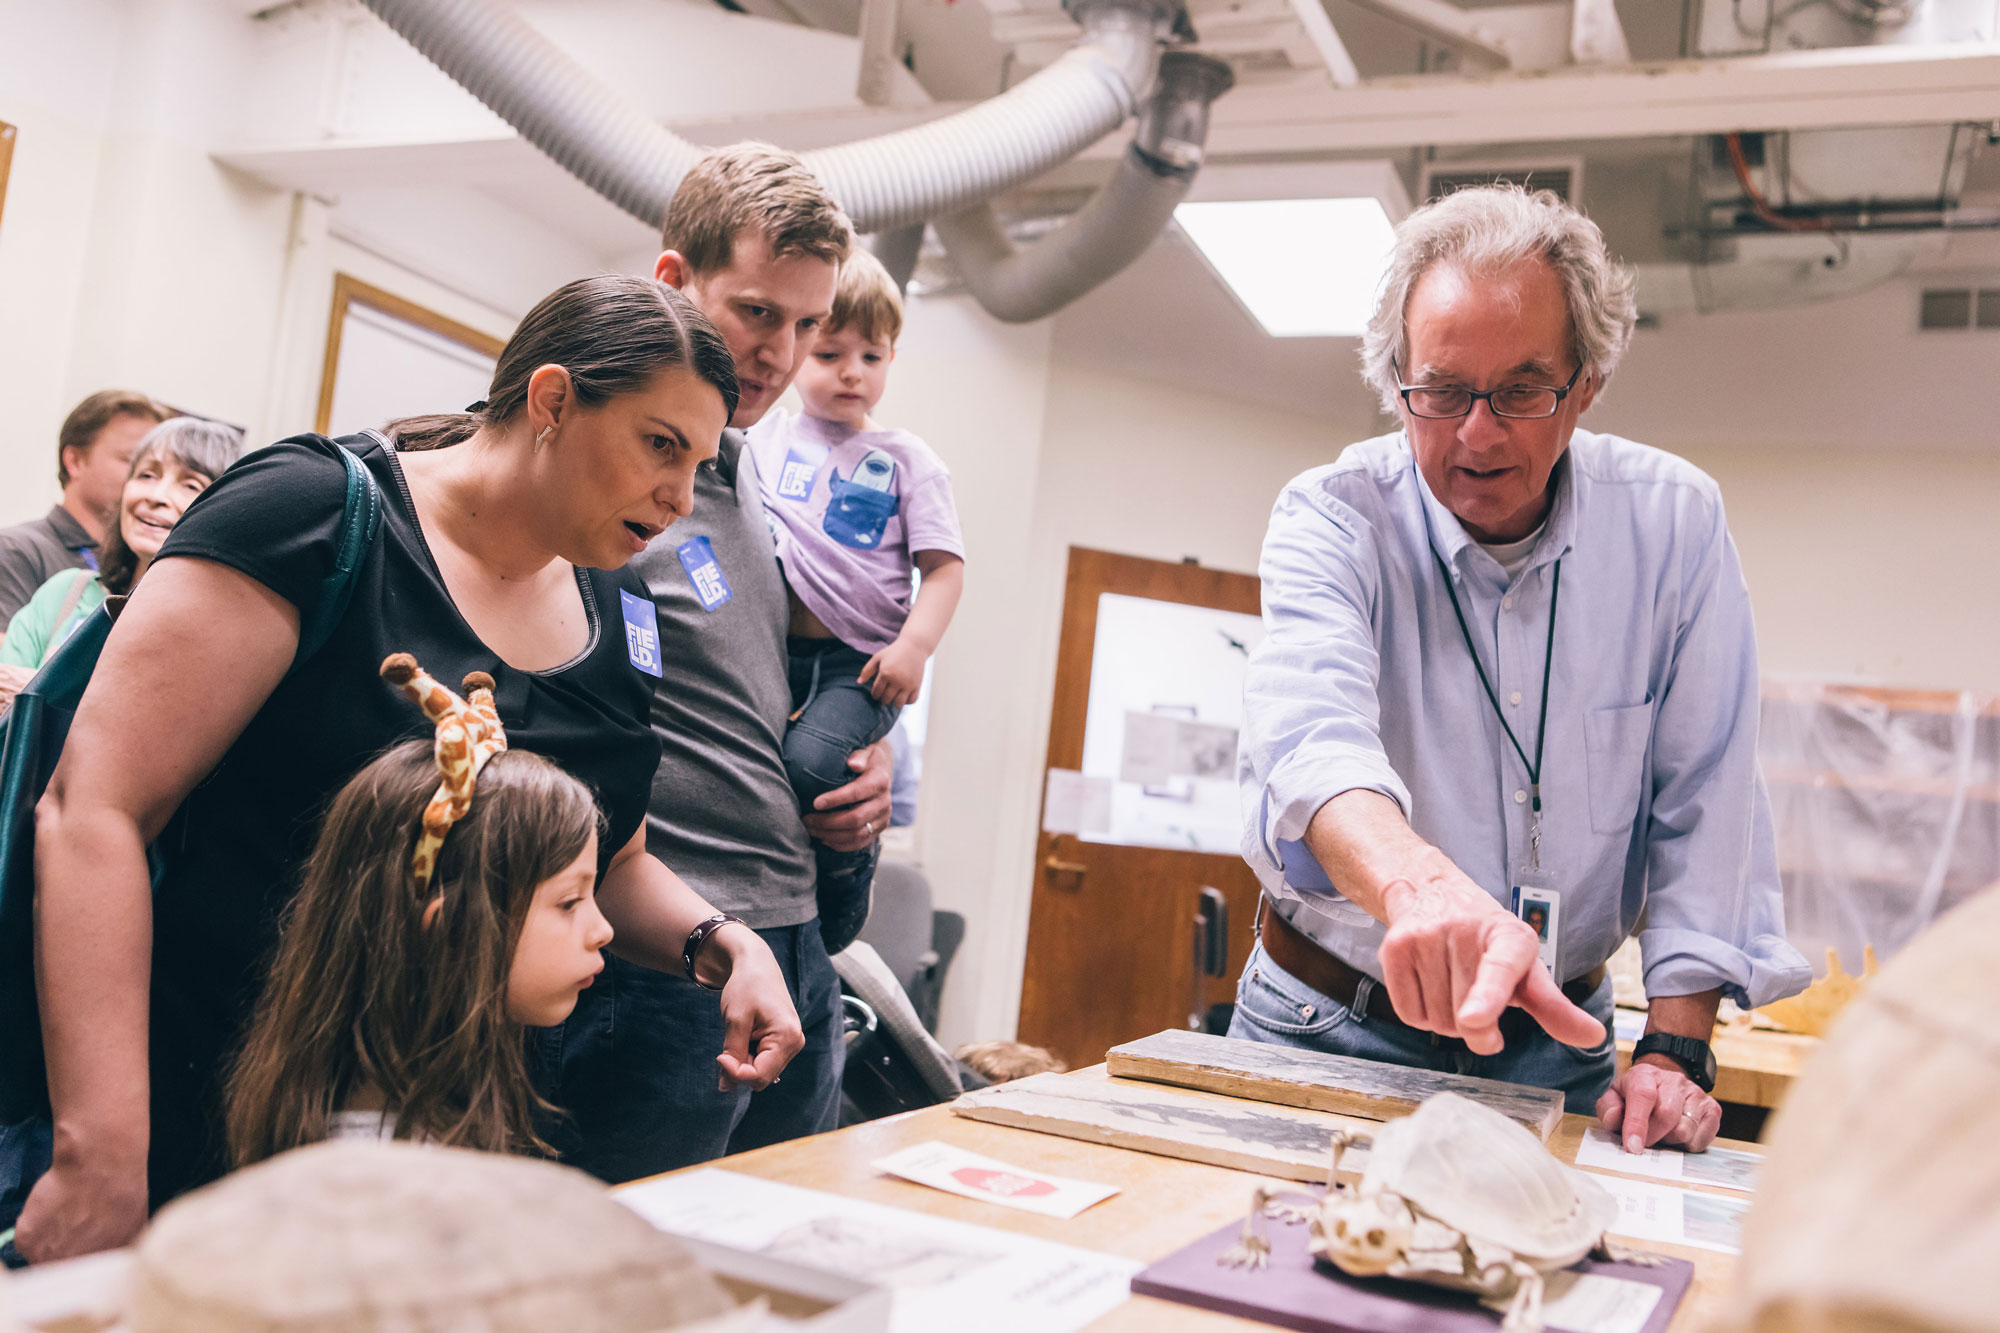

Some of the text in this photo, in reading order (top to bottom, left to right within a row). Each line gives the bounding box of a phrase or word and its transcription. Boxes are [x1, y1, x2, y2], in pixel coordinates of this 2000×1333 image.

[783, 461, 816, 482] FIE
[691, 560, 720, 589] FIE
[699, 581, 727, 606] LD.
[626, 620, 655, 650] FIE
[629, 641, 657, 671] LD.
